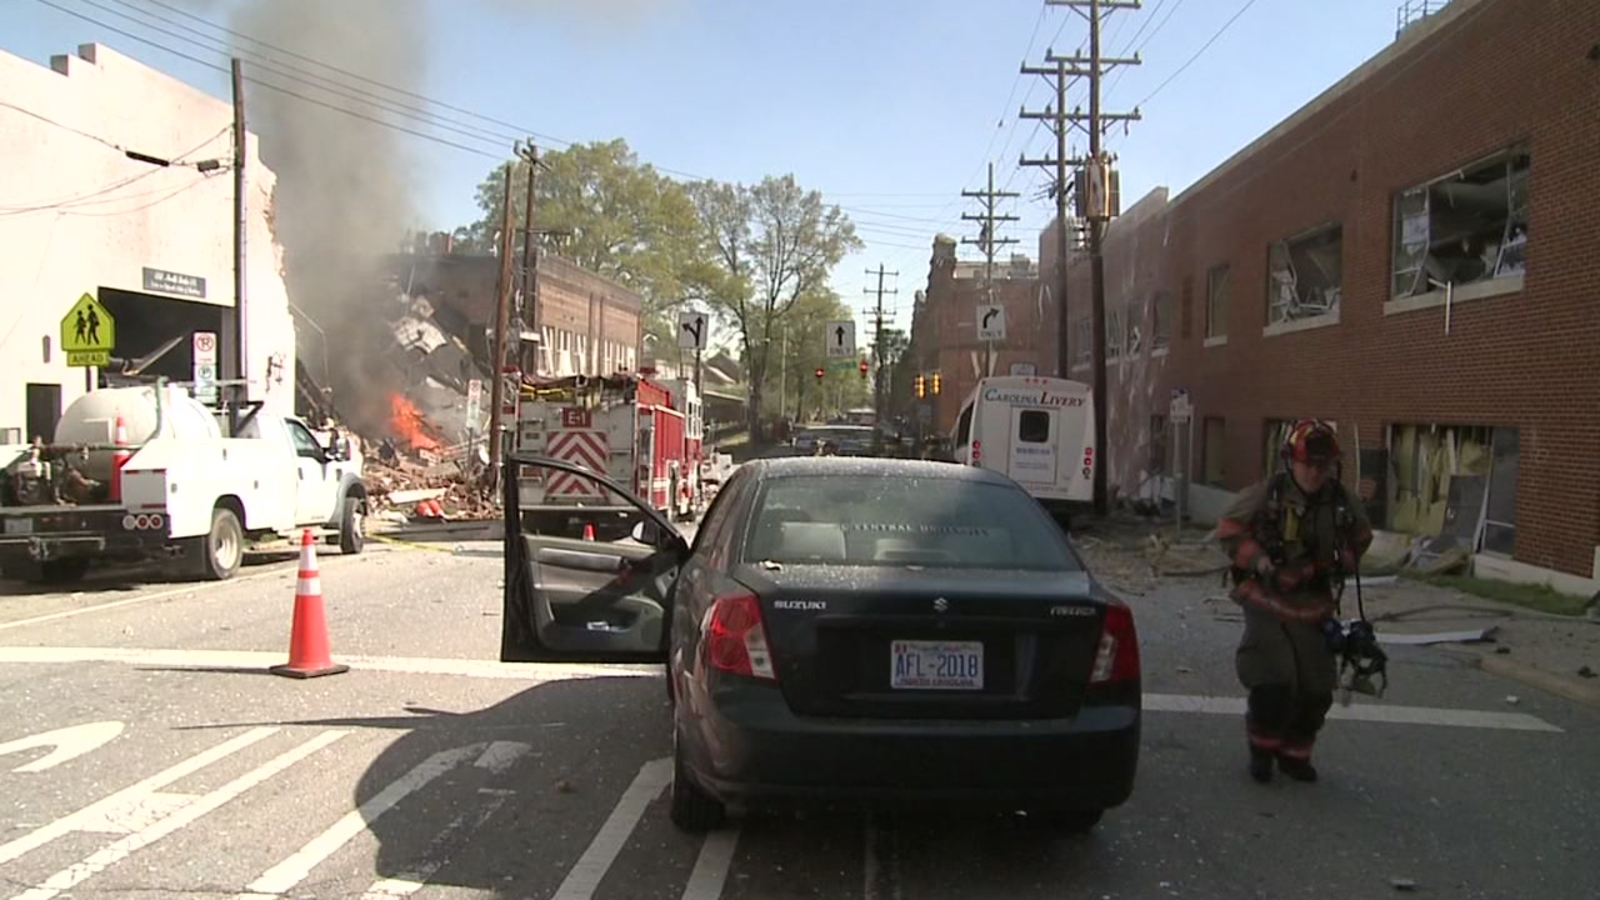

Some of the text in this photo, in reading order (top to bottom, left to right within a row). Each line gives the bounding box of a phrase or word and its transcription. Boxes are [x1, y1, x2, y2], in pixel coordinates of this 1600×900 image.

[72, 353, 104, 363] AHEAD
[1040, 391, 1087, 407] LIVERY
[568, 412, 586, 425] E-1
[773, 600, 826, 610] SUZUKI
[895, 654, 979, 677] AFL-2018
